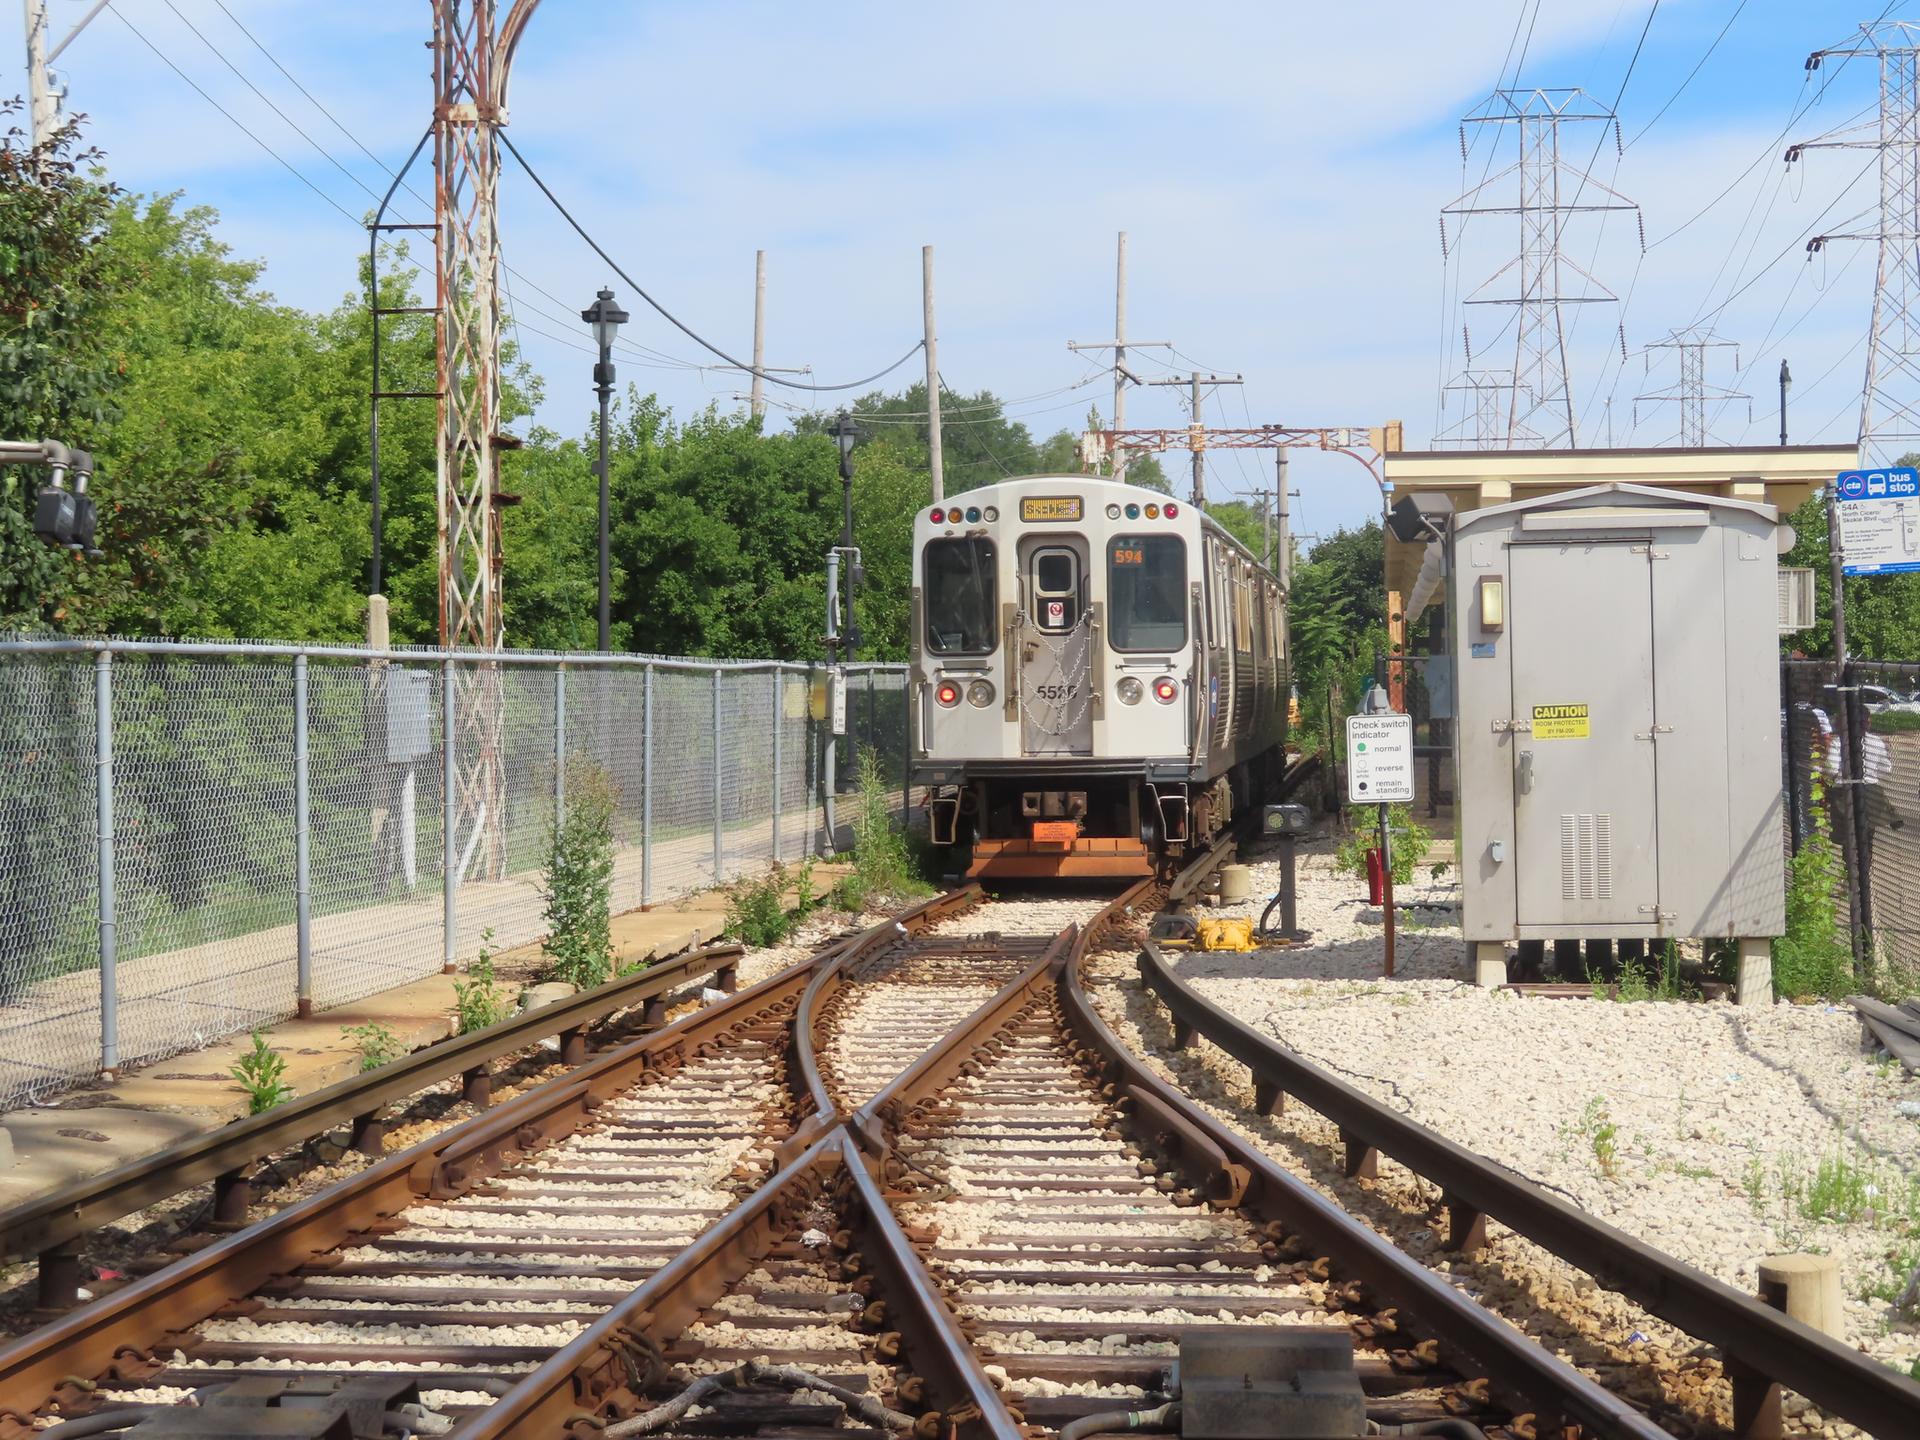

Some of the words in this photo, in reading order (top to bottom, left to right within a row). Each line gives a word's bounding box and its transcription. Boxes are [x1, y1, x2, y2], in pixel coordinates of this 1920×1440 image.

[1889, 472, 1911, 482] bus
[1846, 482, 1861, 490] cta
[1889, 482, 1915, 494] stop
[1842, 503, 1858, 511] 54A
[1114, 549, 1143, 563] 594
[1534, 705, 1587, 718] CAUTION
[1351, 720, 1379, 729] Check
[1380, 719, 1408, 728] switch
[1352, 731, 1390, 739] indicator
[1375, 786, 1410, 794] standing
